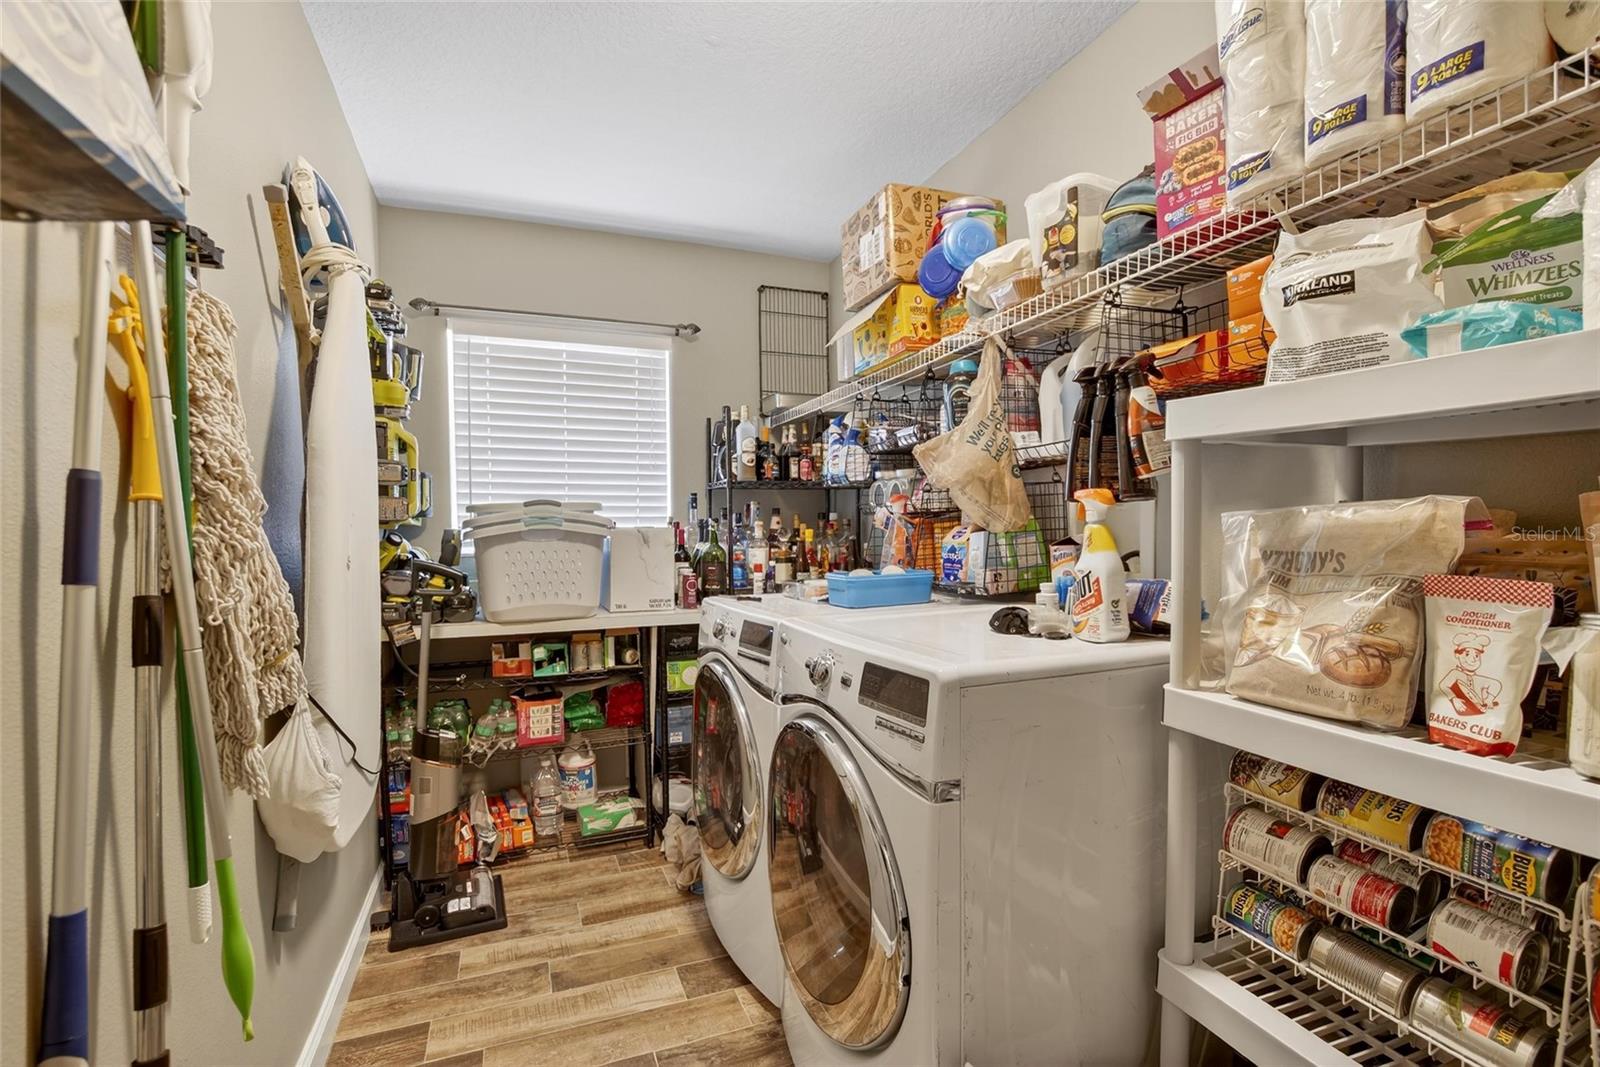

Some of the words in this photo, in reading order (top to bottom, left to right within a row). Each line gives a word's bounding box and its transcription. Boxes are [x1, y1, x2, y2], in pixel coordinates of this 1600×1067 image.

[1417, 74, 1430, 92] 9
[1431, 50, 1473, 76] LARGE
[1432, 62, 1470, 86] ROLLS
[1312, 122, 1322, 136] 9
[1491, 252, 1556, 273] WELLNESS
[1466, 260, 1582, 297] WHIMZEES
[1538, 290, 1565, 302] Treats
[966, 419, 990, 446] We'll
[1446, 615, 1511, 630] CONDITIONER
[1462, 610, 1497, 621] DOUGH
[1428, 712, 1468, 731] BAKERS
[1469, 723, 1502, 741] CLUB
[1511, 853, 1531, 897] BUSH'
